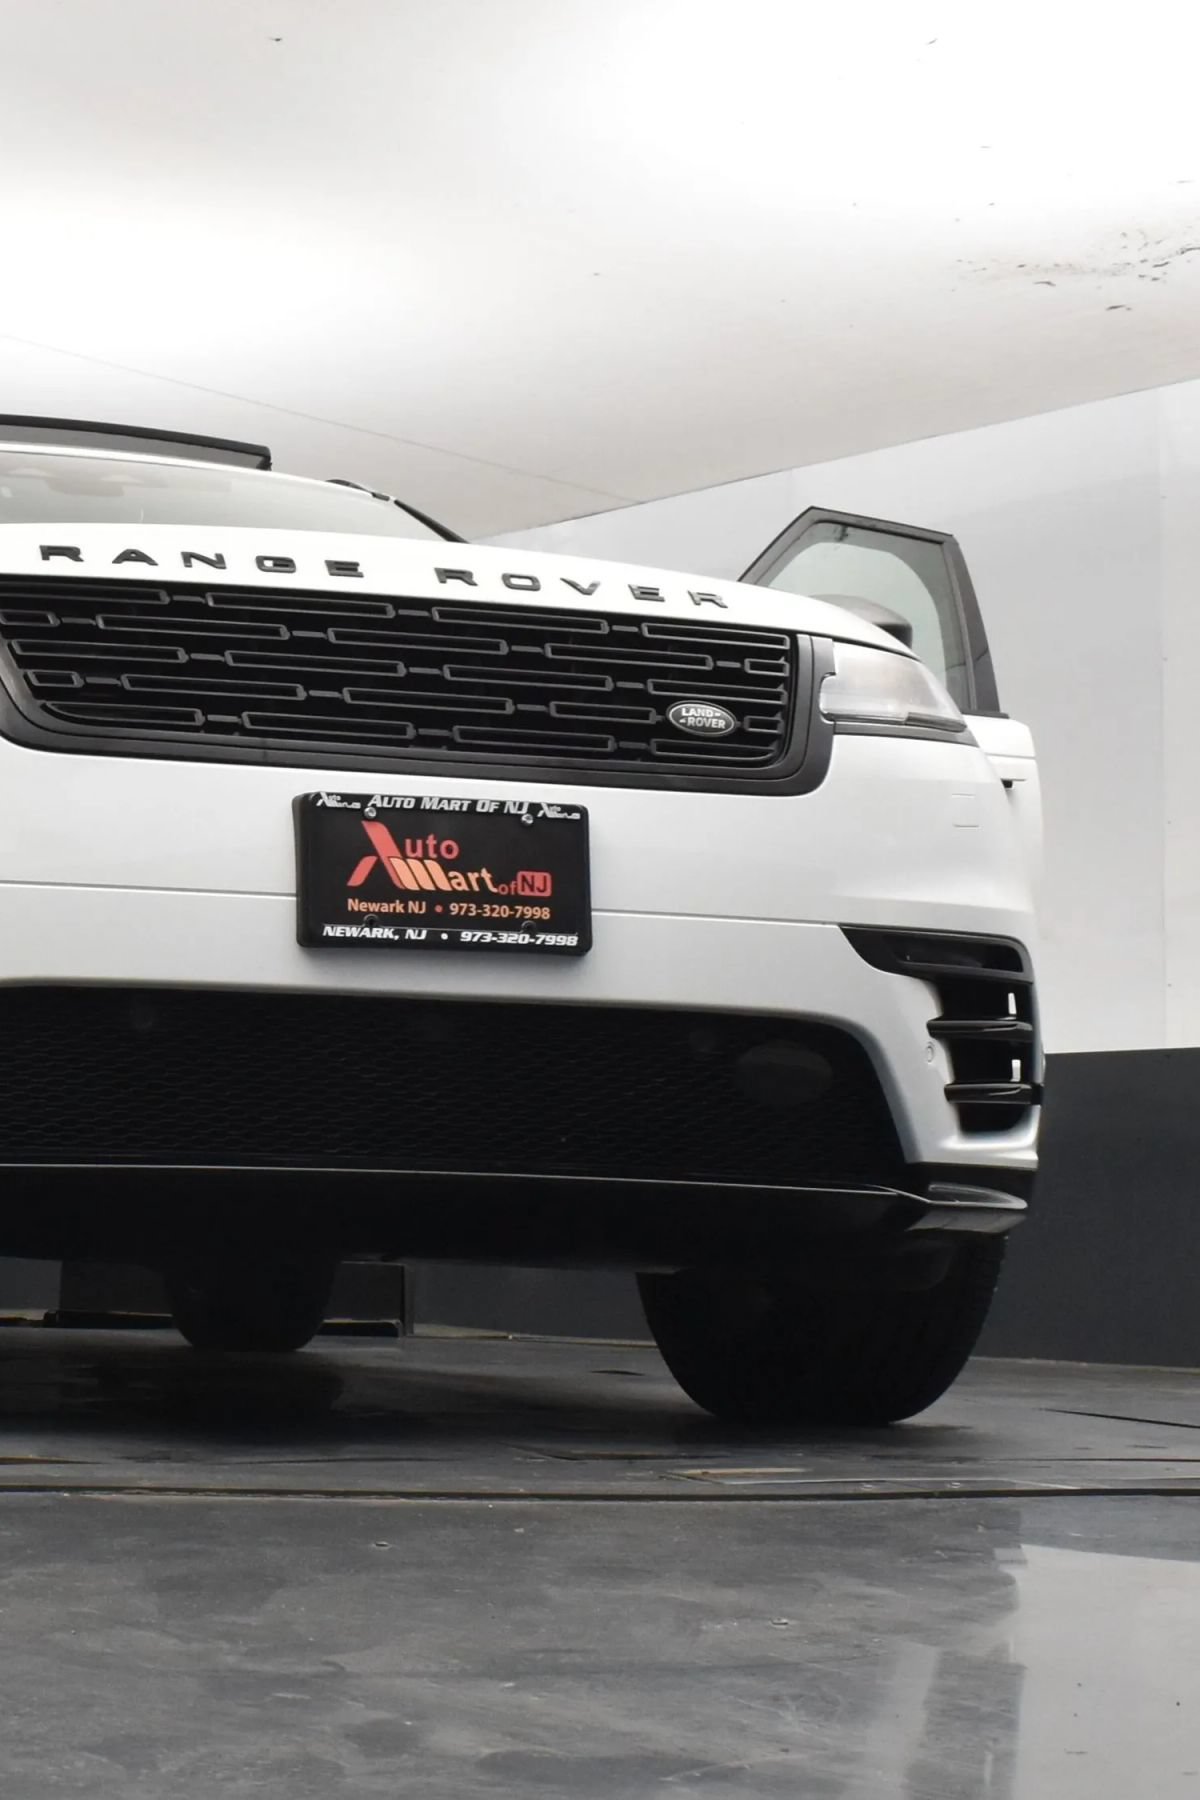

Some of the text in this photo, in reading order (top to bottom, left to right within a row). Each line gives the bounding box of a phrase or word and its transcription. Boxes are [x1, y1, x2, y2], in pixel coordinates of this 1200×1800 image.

[39, 544, 728, 608] RANGE ROVER
[367, 794, 416, 809] AUTO
[420, 797, 471, 812] MART
[503, 801, 530, 814] NJ
[498, 881, 518, 895] of
[520, 874, 547, 893] NJ
[347, 898, 551, 920] Newark NJ 973-320-7998
[323, 926, 579, 946] NEWARK, NJ 973-320-7998
